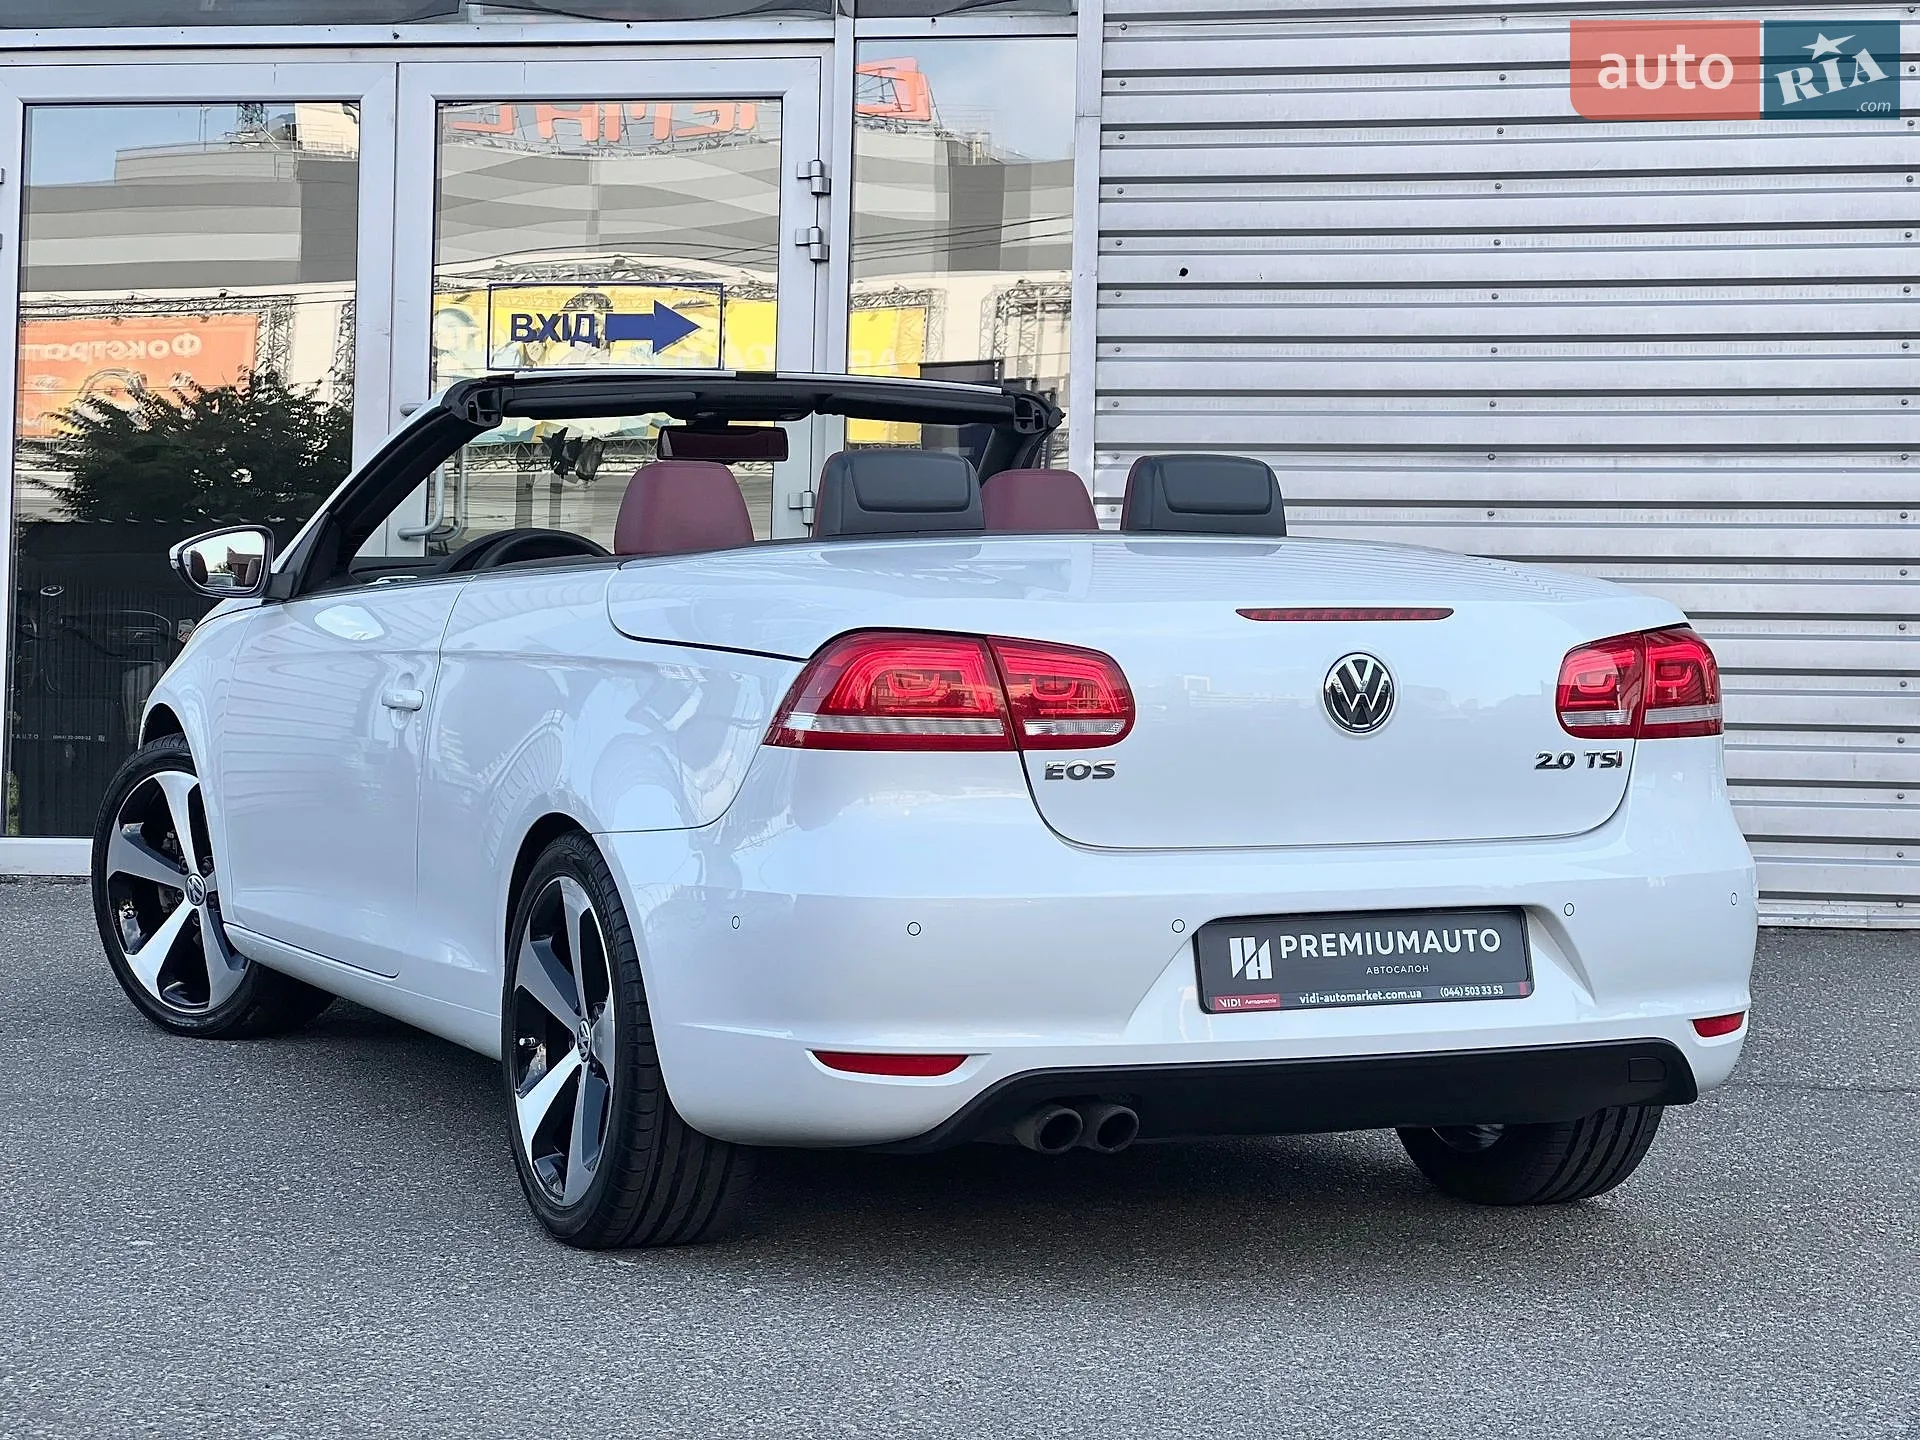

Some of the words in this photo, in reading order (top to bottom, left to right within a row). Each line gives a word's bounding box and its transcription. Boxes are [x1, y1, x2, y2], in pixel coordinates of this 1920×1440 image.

[511, 312, 600, 348] ВХІД
[1583, 749, 1624, 768] TSI
[1044, 759, 1117, 780] EOS
[1280, 928, 1501, 959] PREMIUMAUTO
[1366, 964, 1429, 974] АВТОСАЛОН
[1299, 989, 1422, 1004] vidi-automarket.com.ua
[1440, 986, 1463, 997] (044)
[1464, 986, 1480, 996] 503
[1481, 985, 1492, 995] 33
[1493, 985, 1504, 995] 53
[1218, 998, 1241, 1008] VIDI
